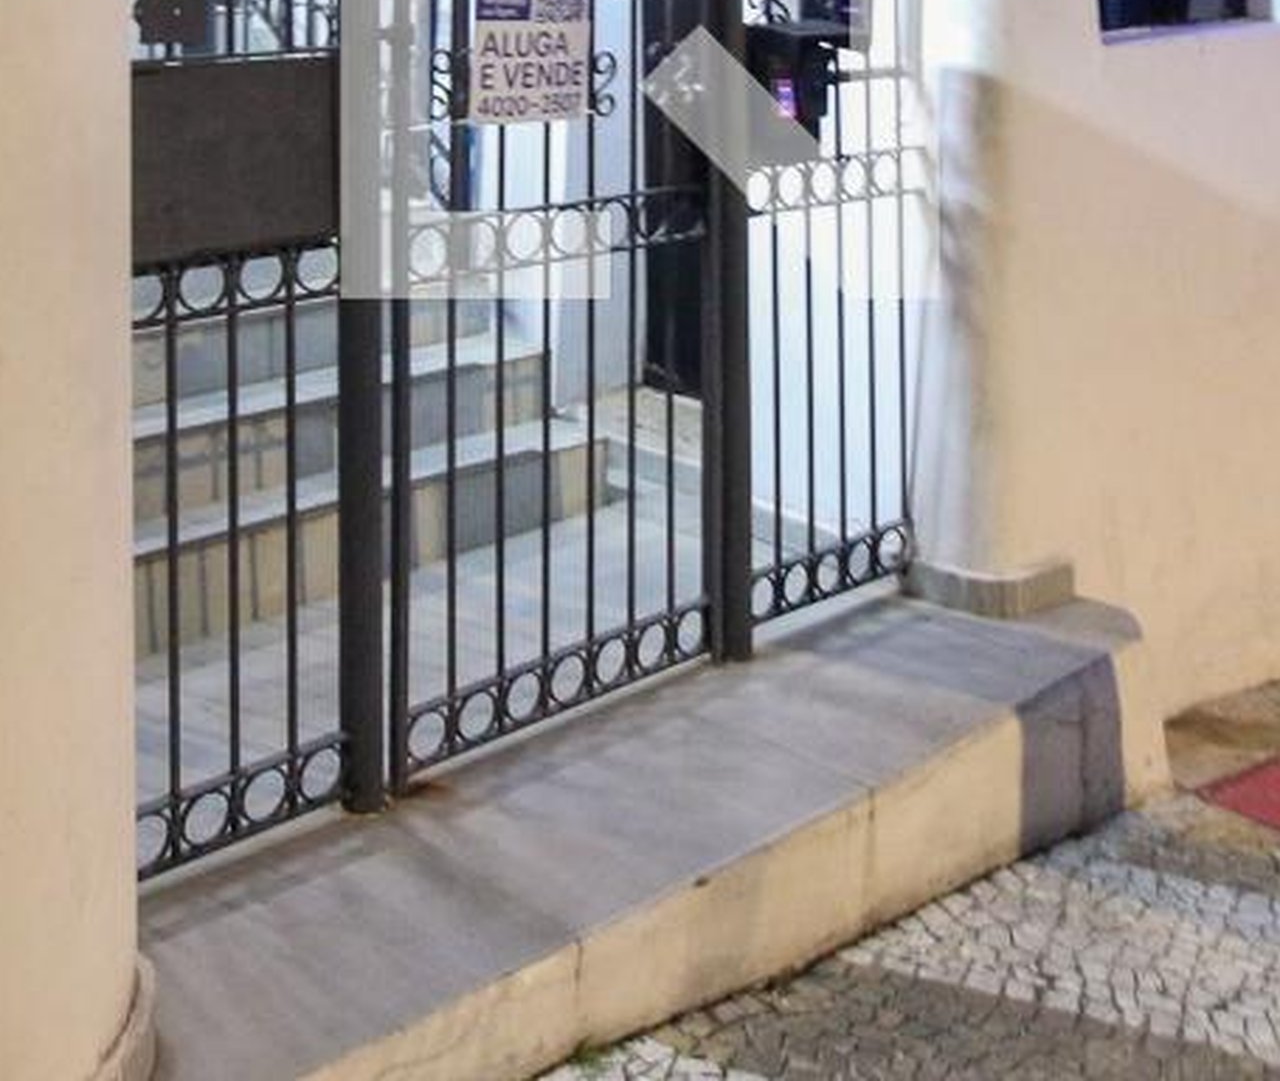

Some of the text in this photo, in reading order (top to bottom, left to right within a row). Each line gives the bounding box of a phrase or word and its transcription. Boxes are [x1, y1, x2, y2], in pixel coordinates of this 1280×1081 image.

[480, 31, 569, 58] ALUGA
[481, 61, 584, 90] E VENDE
